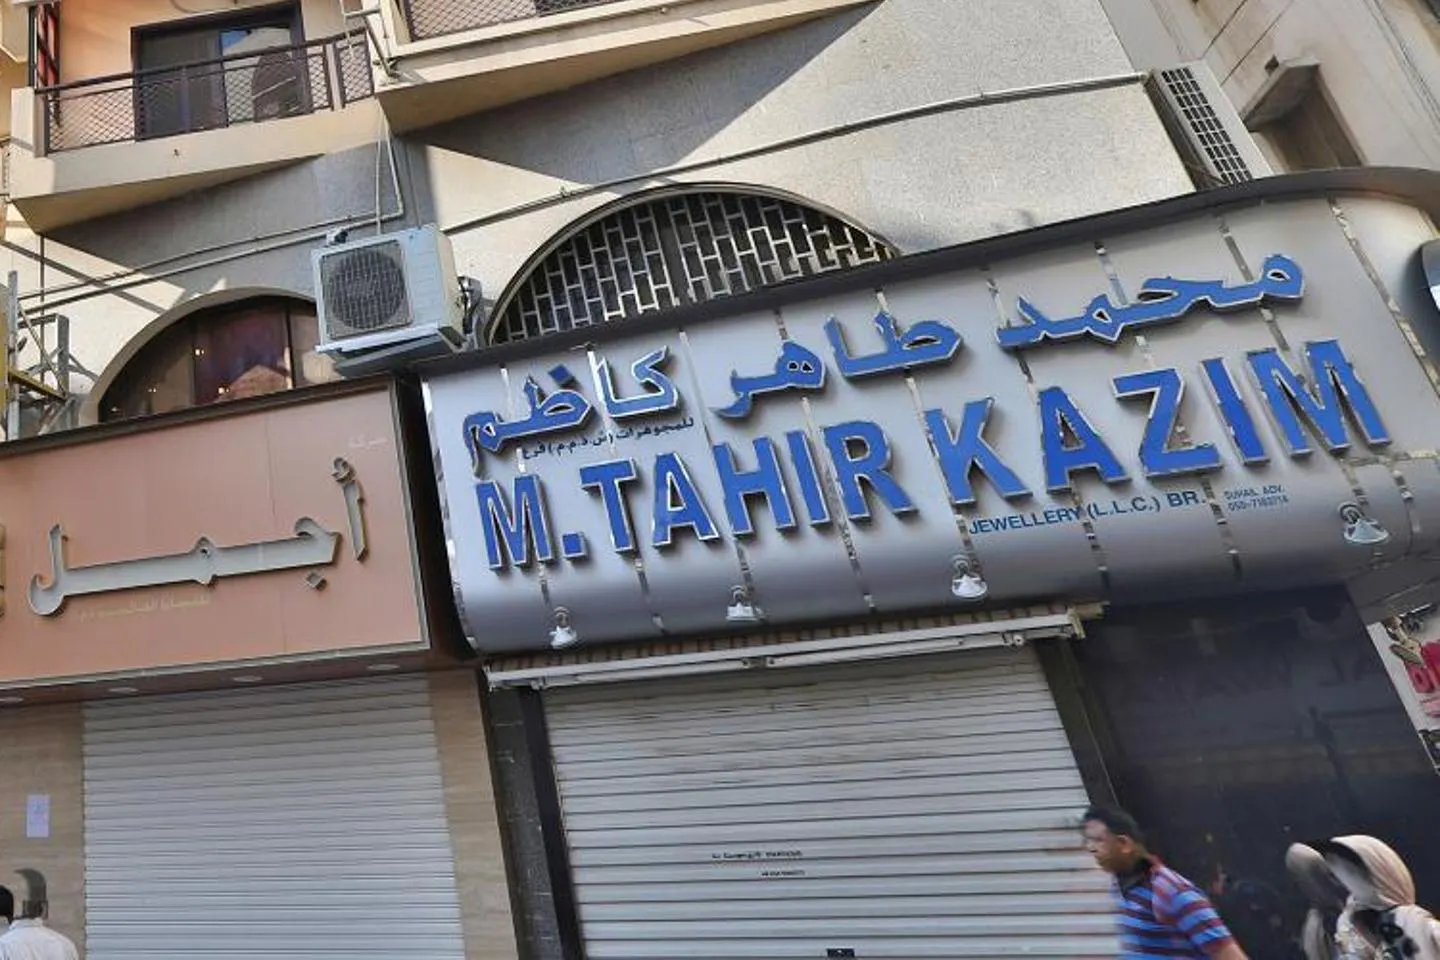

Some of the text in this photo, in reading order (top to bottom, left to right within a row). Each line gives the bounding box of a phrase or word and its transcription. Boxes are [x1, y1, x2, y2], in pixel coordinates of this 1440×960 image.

[462, 252, 1308, 476] محمد طاهر كاظم
[615, 416, 695, 441] للمجوهرات
[925, 338, 1393, 506] KAZIM
[28, 456, 369, 618] أجمل
[968, 490, 1207, 535] JEWELLERY (L.L.C.) BR.
